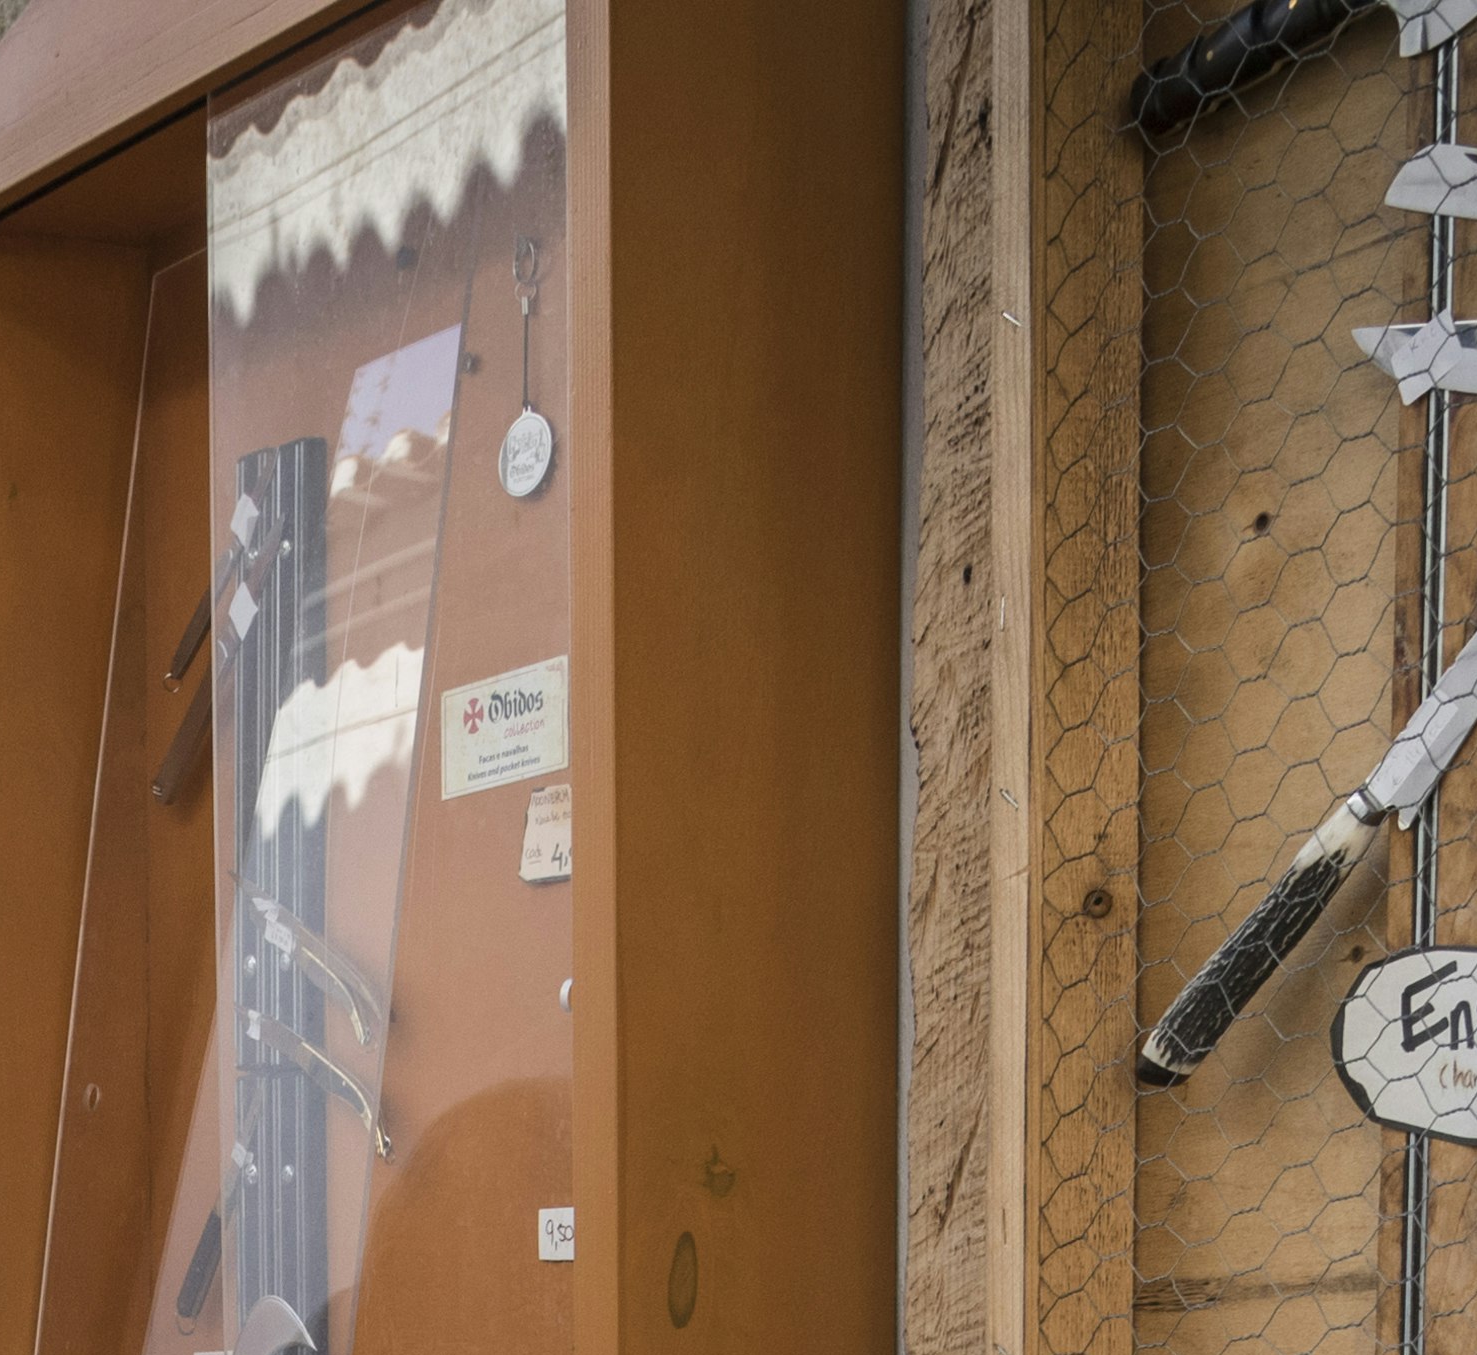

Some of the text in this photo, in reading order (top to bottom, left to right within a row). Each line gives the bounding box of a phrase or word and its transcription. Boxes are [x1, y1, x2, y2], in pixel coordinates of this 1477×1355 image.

[503, 718, 545, 739] collection
[479, 753, 495, 765] Facas
[501, 745, 529, 758] navalhas
[467, 769, 487, 782] Knives
[499, 761, 521, 776] pocket
[521, 756, 541, 768] knives
